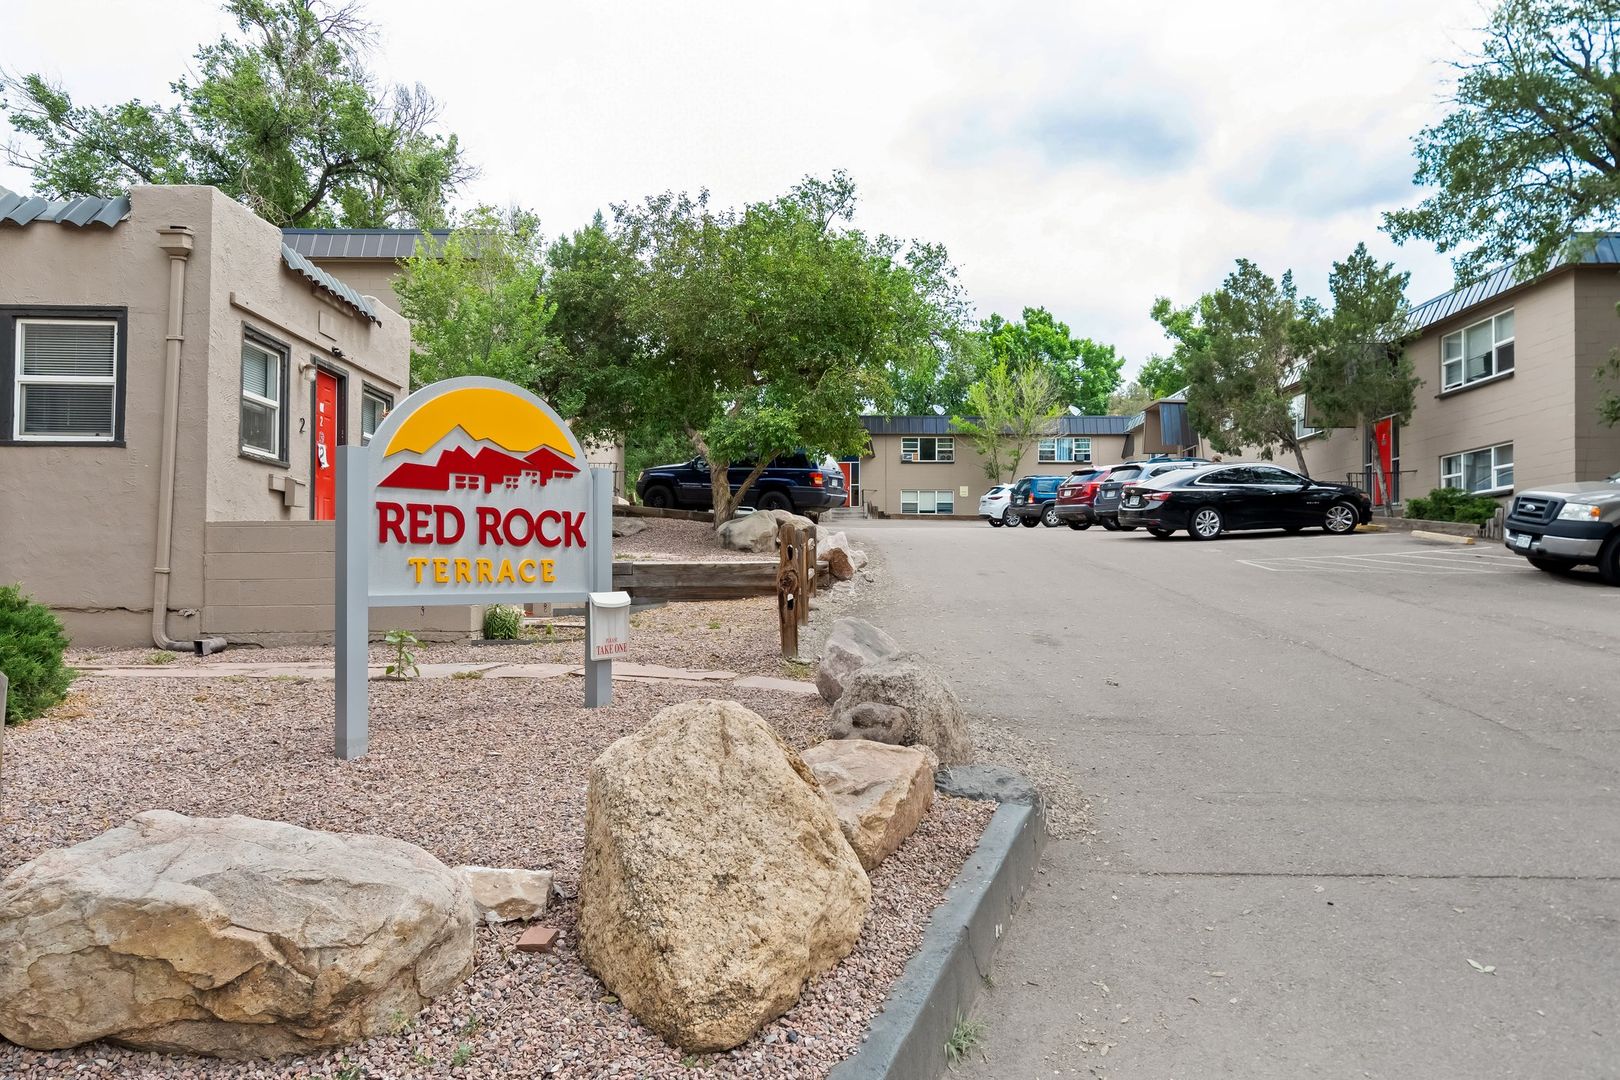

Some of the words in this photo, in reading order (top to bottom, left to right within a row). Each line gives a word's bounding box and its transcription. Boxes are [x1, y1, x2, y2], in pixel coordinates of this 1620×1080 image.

[299, 417, 306, 433] 2
[375, 501, 466, 545] RED
[475, 506, 587, 548] ROCK
[408, 557, 556, 584] TERRACE
[597, 645, 613, 655] TAKE
[614, 643, 627, 653] ONE
